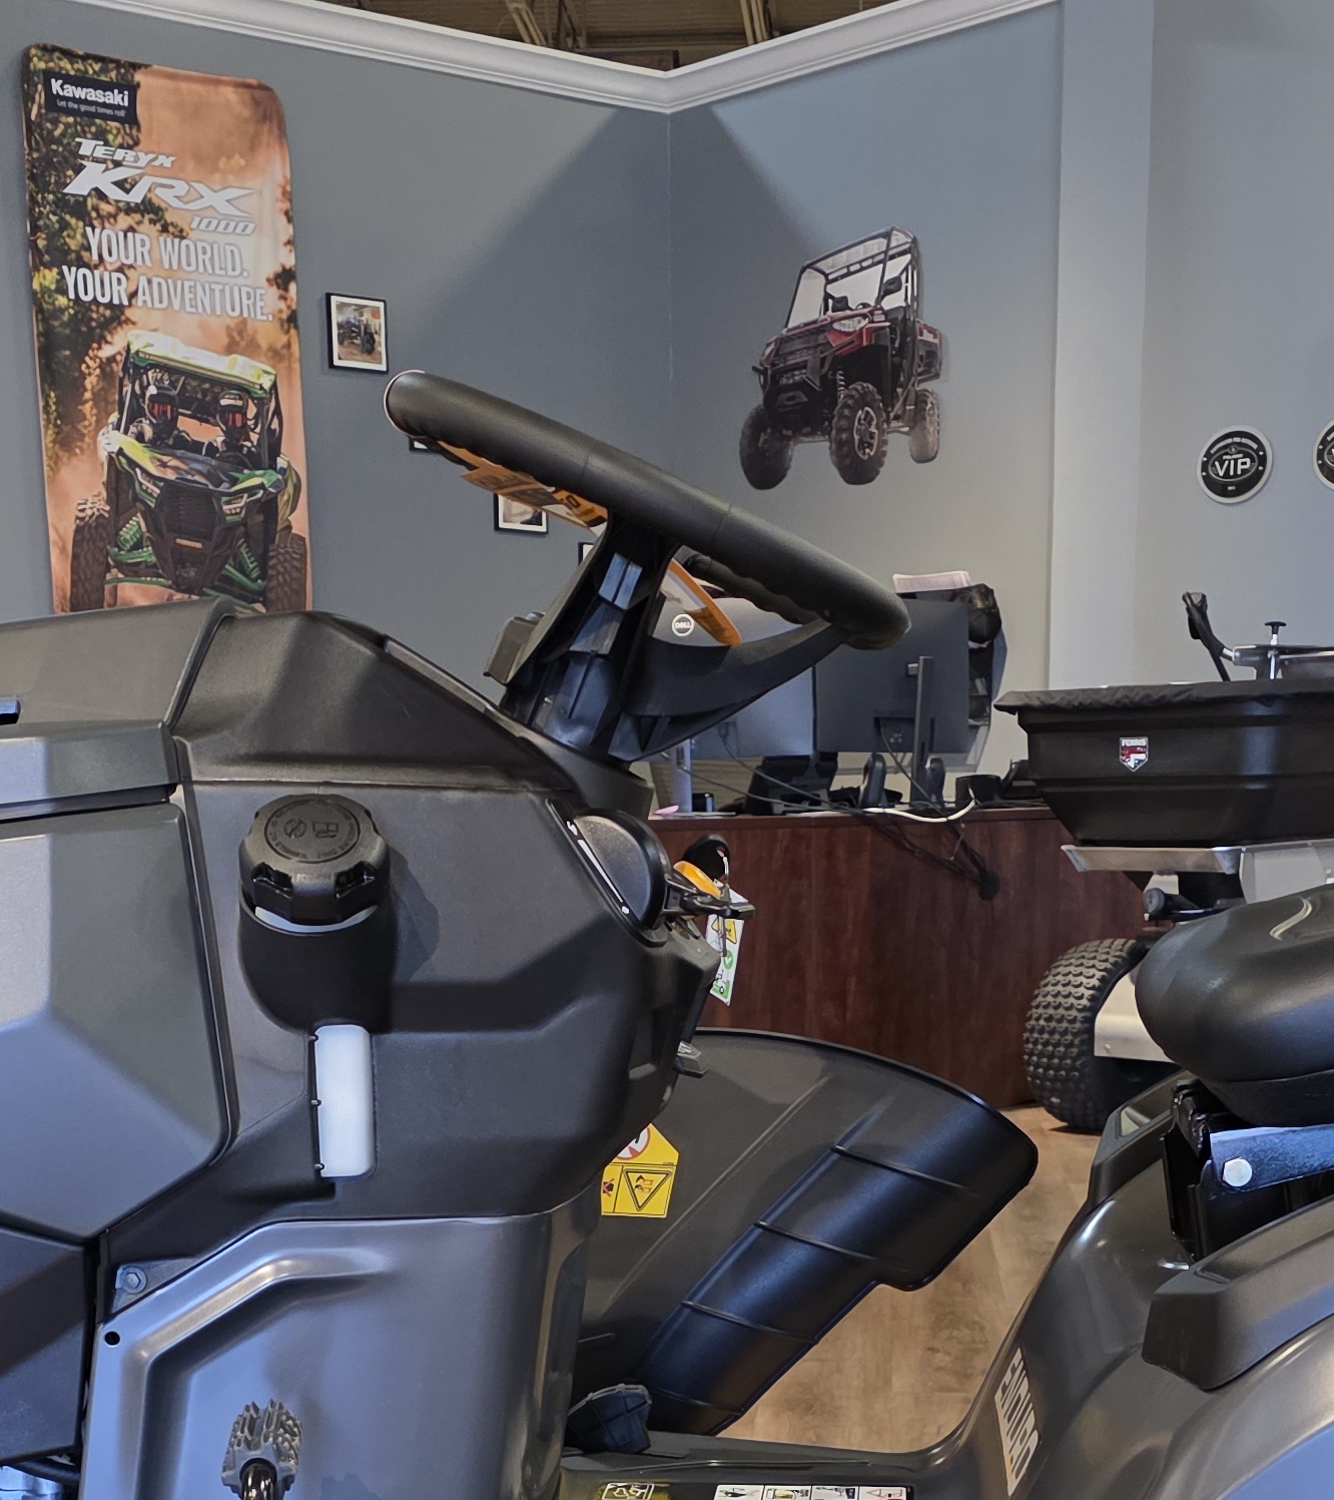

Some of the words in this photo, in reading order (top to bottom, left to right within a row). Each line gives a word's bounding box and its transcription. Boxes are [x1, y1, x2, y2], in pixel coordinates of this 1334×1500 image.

[51, 78, 128, 106] Kawasaki
[74, 137, 177, 168] TERYX
[62, 161, 256, 218] KRX
[190, 216, 256, 235] 1000
[85, 226, 152, 267] YOUR
[159, 238, 249, 278] WORLD.
[62, 264, 130, 306] YOUR
[137, 276, 273, 321] ADVENTURE.
[1214, 457, 1251, 477] VIP
